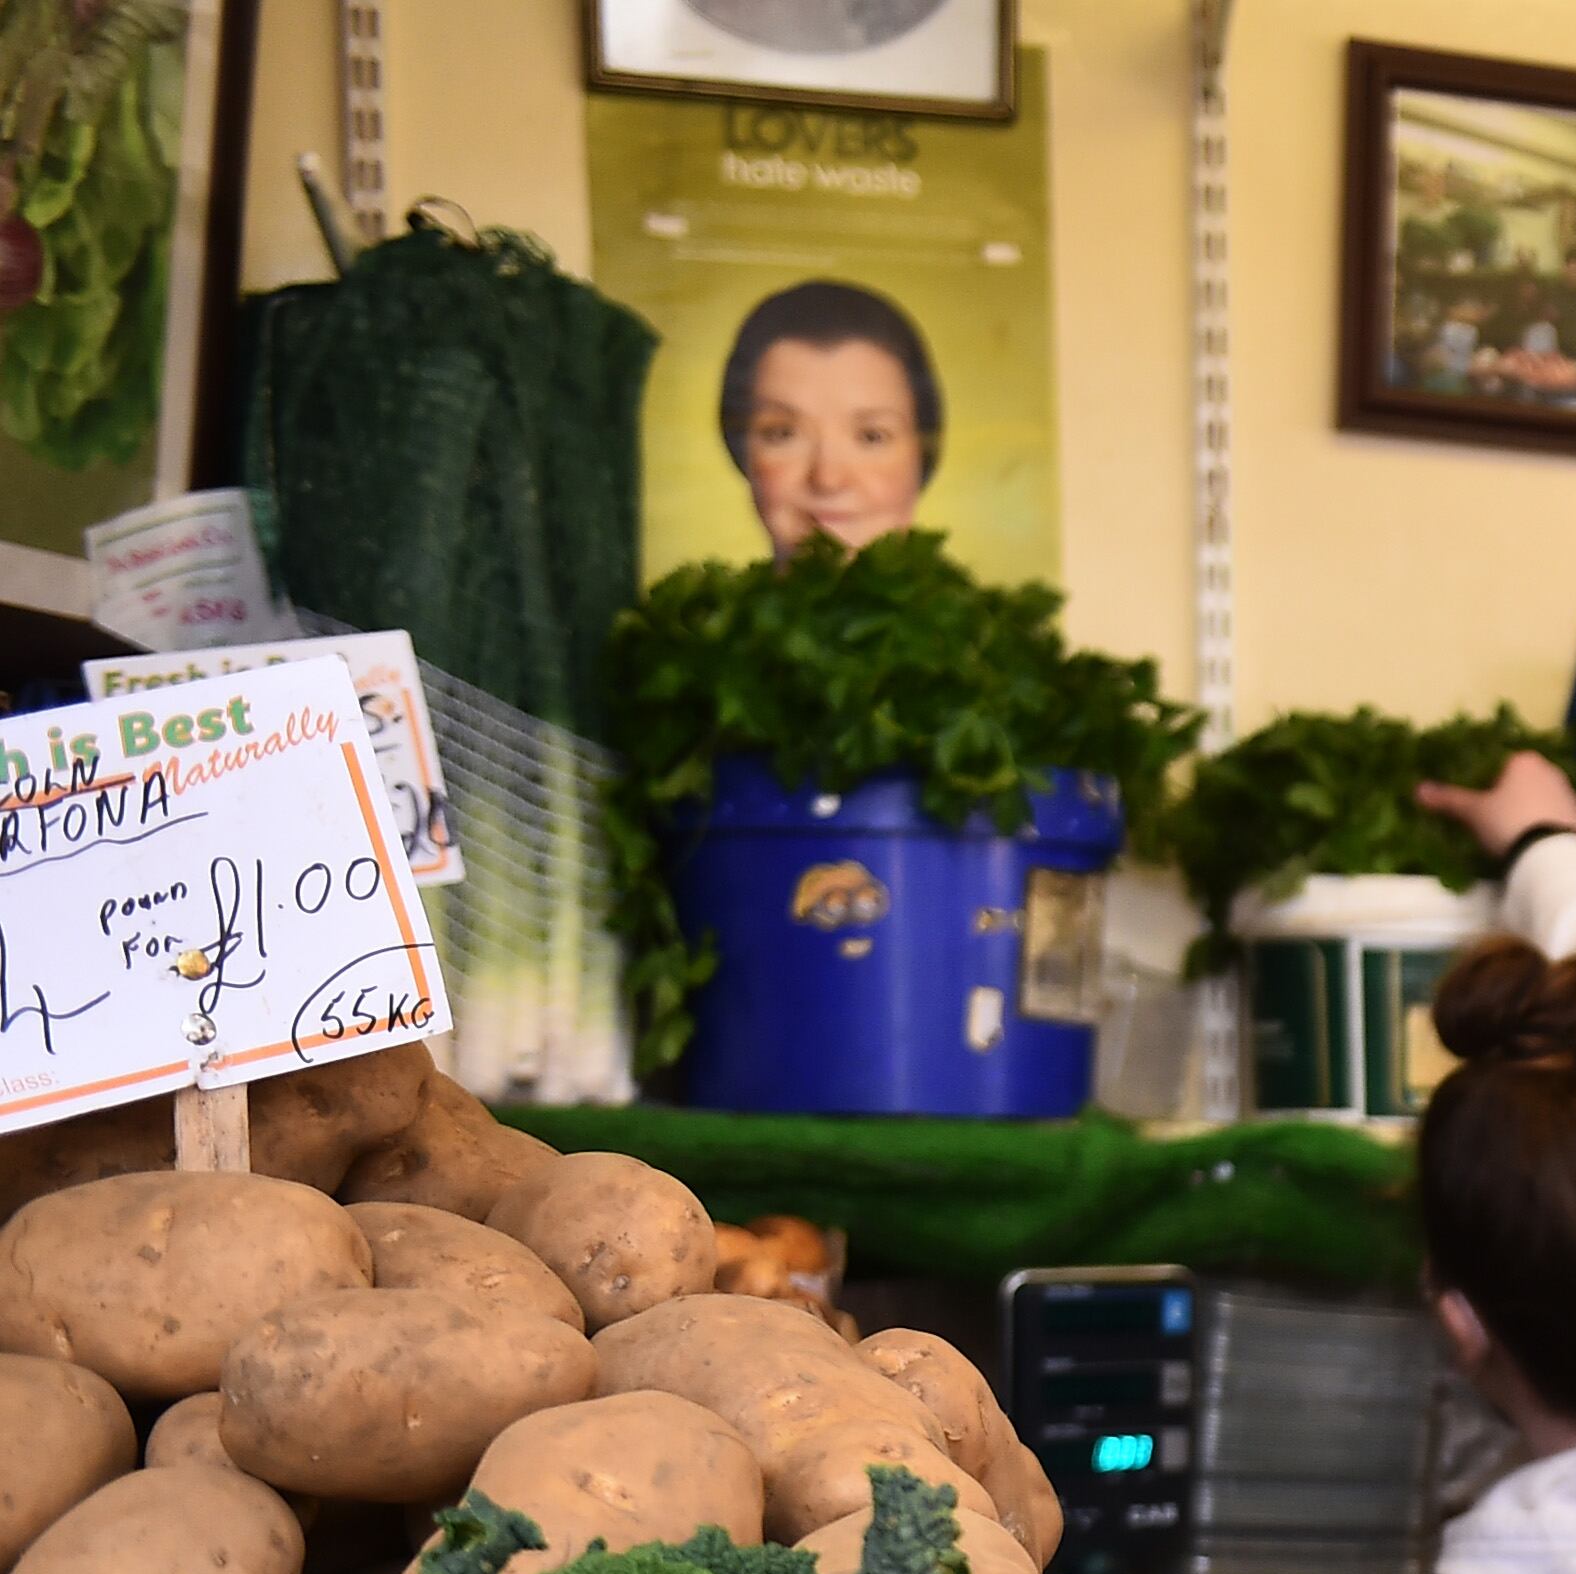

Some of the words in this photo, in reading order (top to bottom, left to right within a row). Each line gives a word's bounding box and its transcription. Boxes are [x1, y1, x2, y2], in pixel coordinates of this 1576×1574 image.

[720, 149, 809, 193] hate
[813, 161, 922, 200] waste
[118, 695, 256, 759] Best
[142, 706, 340, 796] Naturally
